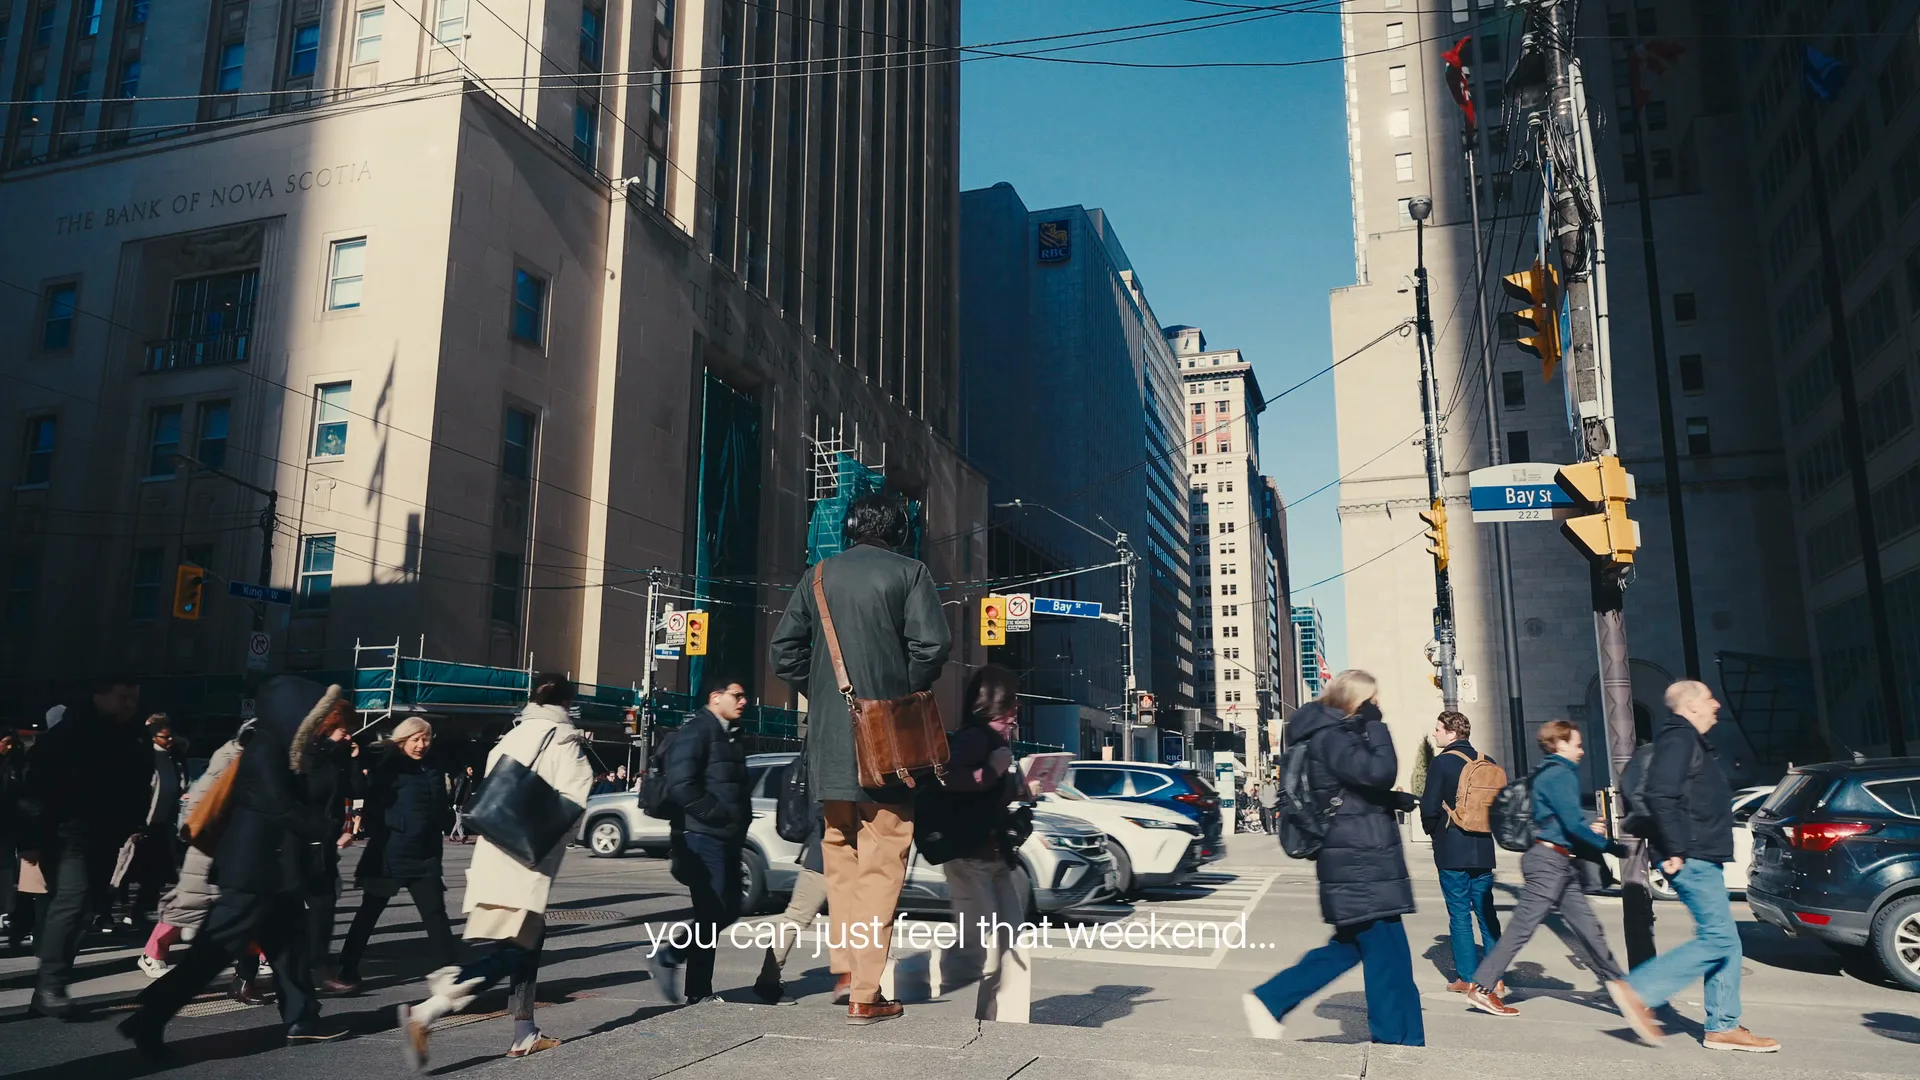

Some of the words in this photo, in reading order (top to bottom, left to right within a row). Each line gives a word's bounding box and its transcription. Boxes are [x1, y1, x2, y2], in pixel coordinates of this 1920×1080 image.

[55, 211, 94, 235] THE
[104, 198, 162, 226] BANK
[172, 192, 200, 214] OF
[210, 176, 274, 208] NOVA
[285, 160, 372, 194] SCOTIA
[1041, 247, 1067, 259] RBC
[688, 279, 733, 336] THE
[1505, 487, 1535, 507] Bay
[1539, 489, 1552, 503] St
[1518, 510, 1540, 520] 222
[243, 585, 263, 599] King
[271, 590, 279, 600] W
[1053, 600, 1072, 614] Bay
